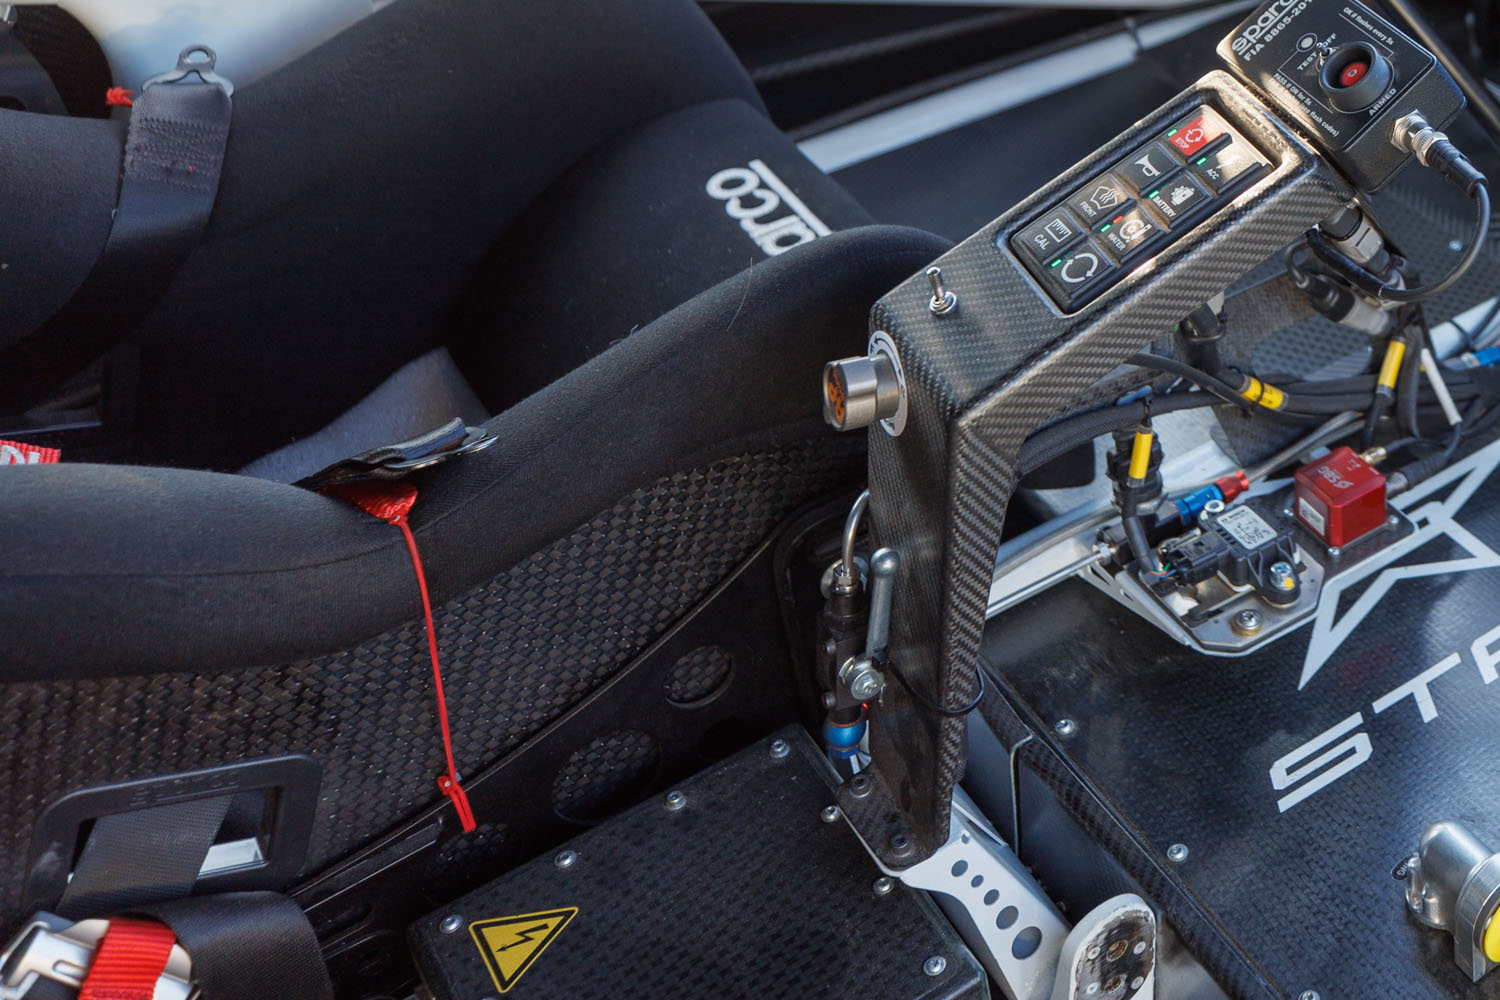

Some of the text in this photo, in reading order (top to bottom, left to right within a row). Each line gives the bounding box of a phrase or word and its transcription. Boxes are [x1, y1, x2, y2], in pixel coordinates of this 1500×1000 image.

[1343, 6, 1354, 16] OK
[1355, 15, 1374, 31] flashes
[1372, 28, 1387, 41] every
[1385, 37, 1394, 45] 5s
[1322, 32, 1337, 48] OFF
[1243, 43, 1265, 62] FIA
[1297, 51, 1318, 71] TEST
[1273, 73, 1288, 85] PASS
[1290, 86, 1300, 95] ON
[1296, 91, 1306, 101] for
[1303, 97, 1312, 106] 5s
[1368, 87, 1397, 117] ARMED
[1309, 110, 1323, 124] flash
[1321, 121, 1340, 137] codes)
[1174, 137, 1190, 149] STOP
[1205, 168, 1220, 180] ACC
[705, 158, 833, 257] arco
[1079, 201, 1097, 217] FRONT
[1152, 195, 1177, 218] BATTERY
[1034, 234, 1049, 250] CAL
[1107, 232, 1126, 251] WATER
